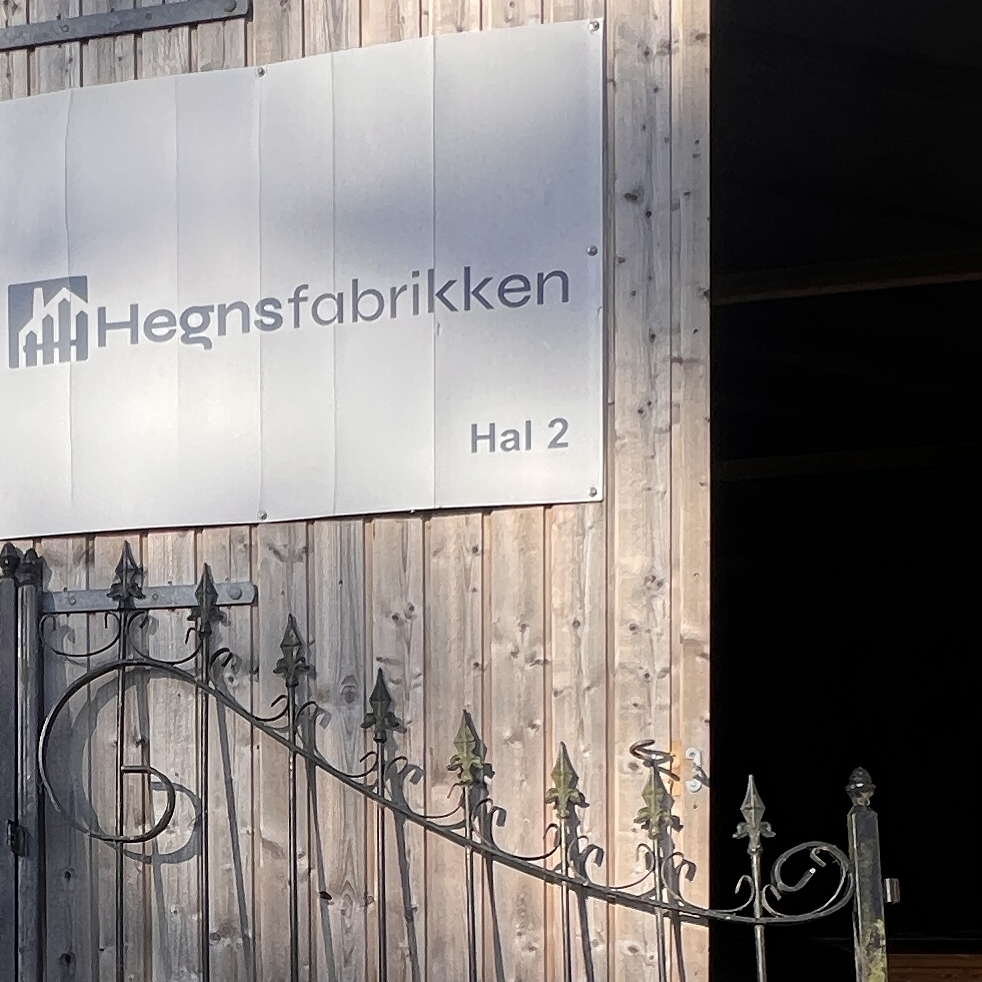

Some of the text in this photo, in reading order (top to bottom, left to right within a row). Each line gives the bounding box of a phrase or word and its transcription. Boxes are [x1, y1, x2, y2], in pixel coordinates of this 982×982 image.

[97, 265, 570, 350] Hegnsfabrikken
[470, 417, 569, 454] Hal 2
